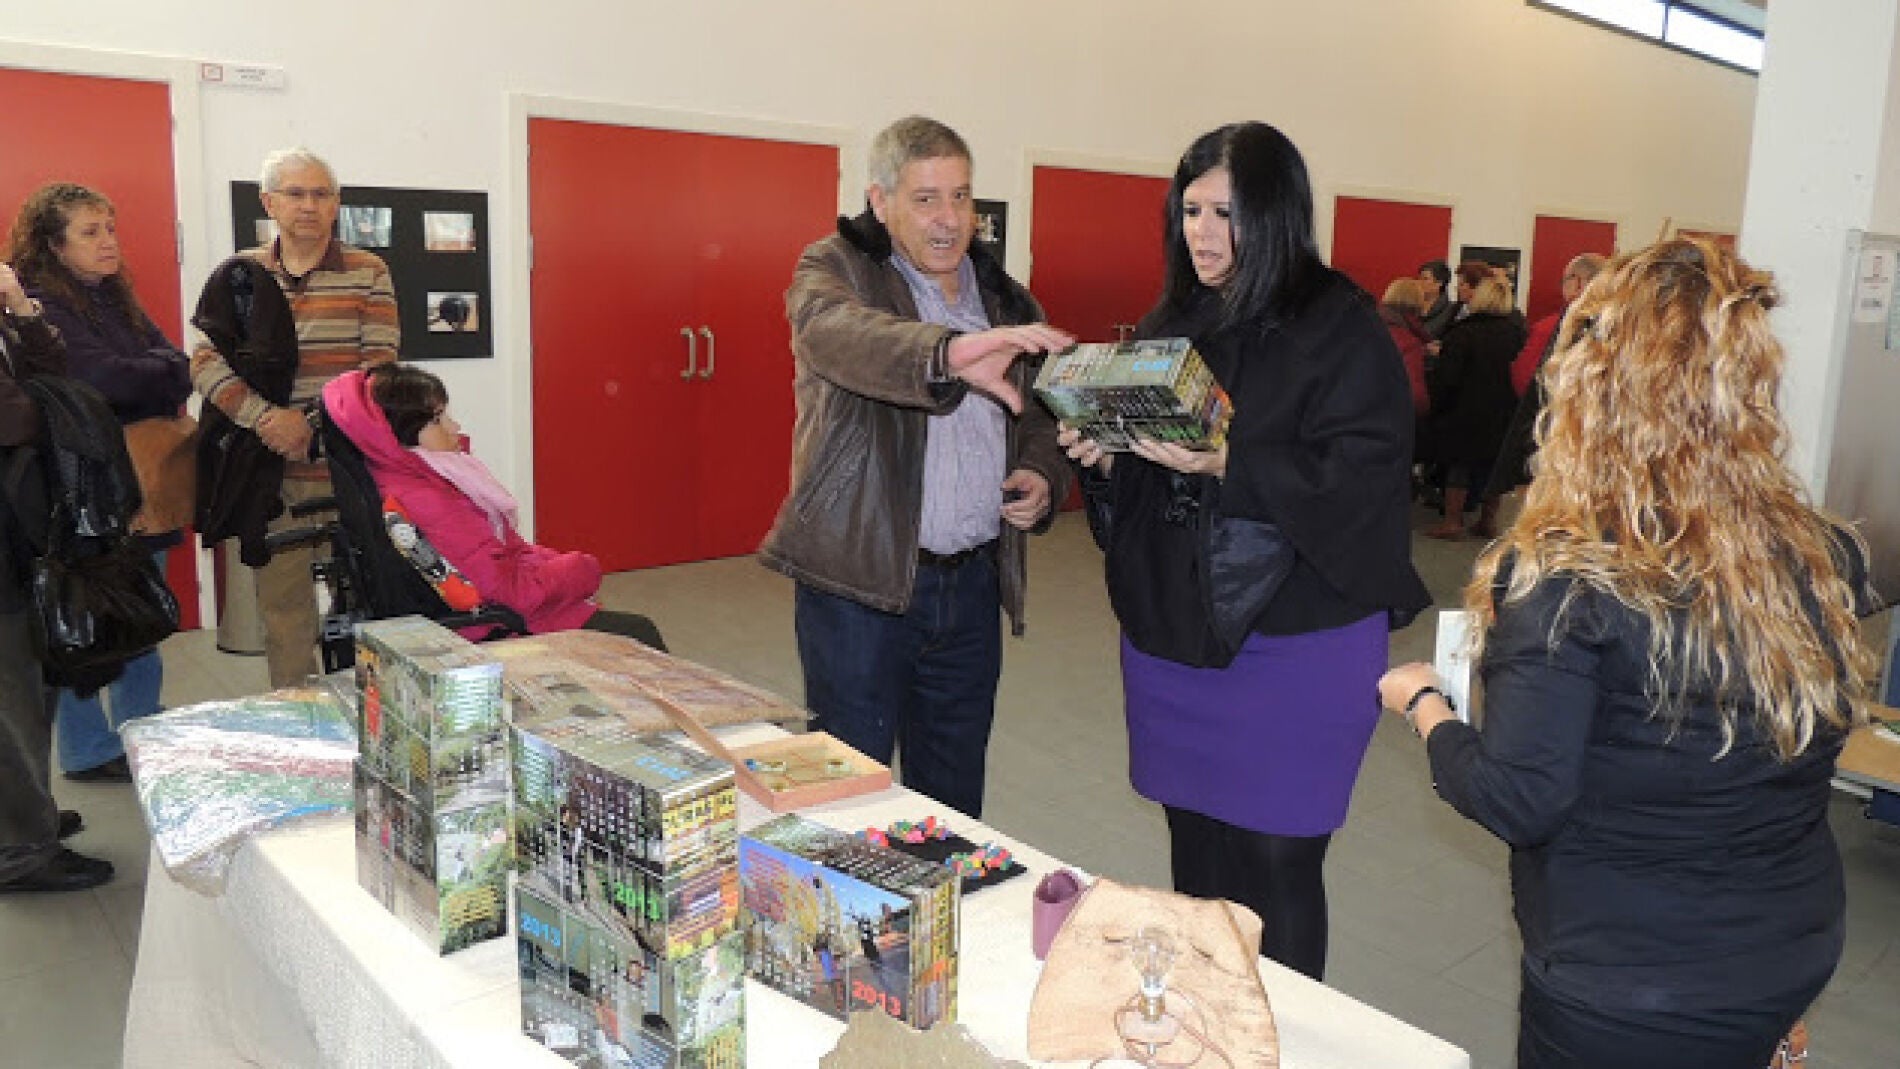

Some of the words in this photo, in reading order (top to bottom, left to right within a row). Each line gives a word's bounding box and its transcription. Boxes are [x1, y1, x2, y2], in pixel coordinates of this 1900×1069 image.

[614, 881, 661, 922] 2013
[520, 910, 561, 947] 2013
[851, 979, 902, 1017] 2013
